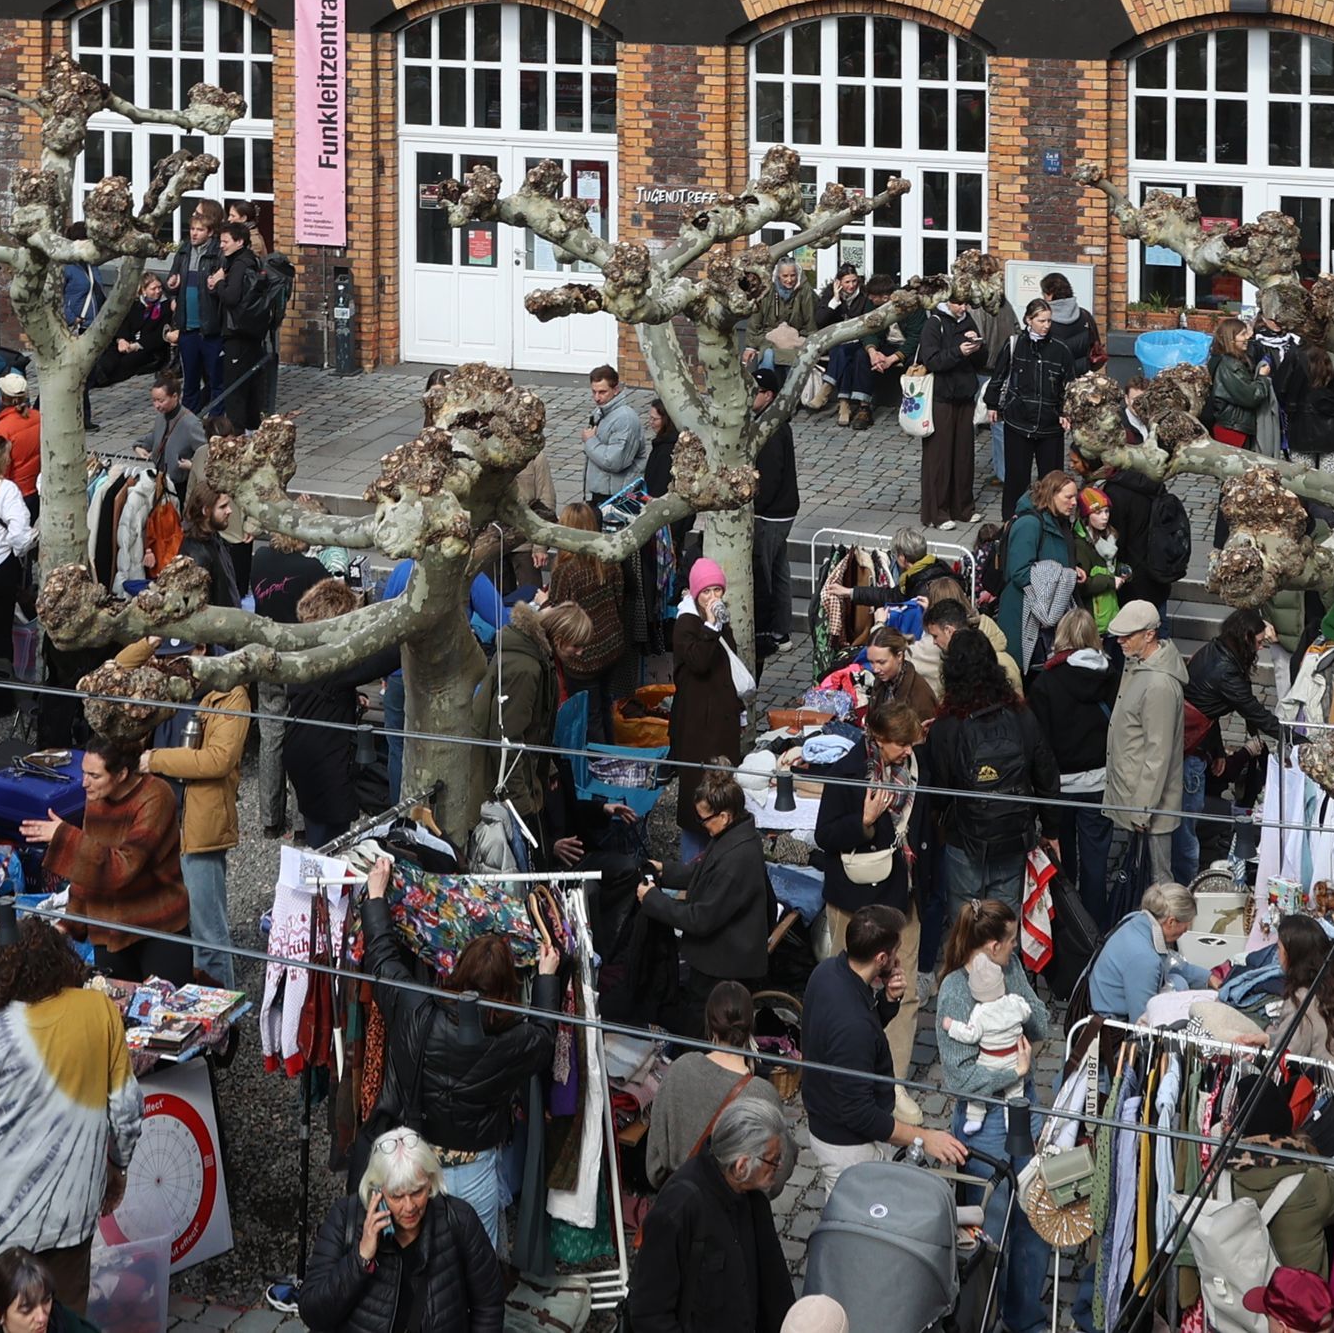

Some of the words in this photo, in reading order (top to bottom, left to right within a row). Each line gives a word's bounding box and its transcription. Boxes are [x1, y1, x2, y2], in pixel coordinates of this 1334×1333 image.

[634, 186, 717, 204] JUGENDTREFF
[1087, 1054, 1097, 1080] 1987
[1087, 1087, 1096, 1118] AUTY
